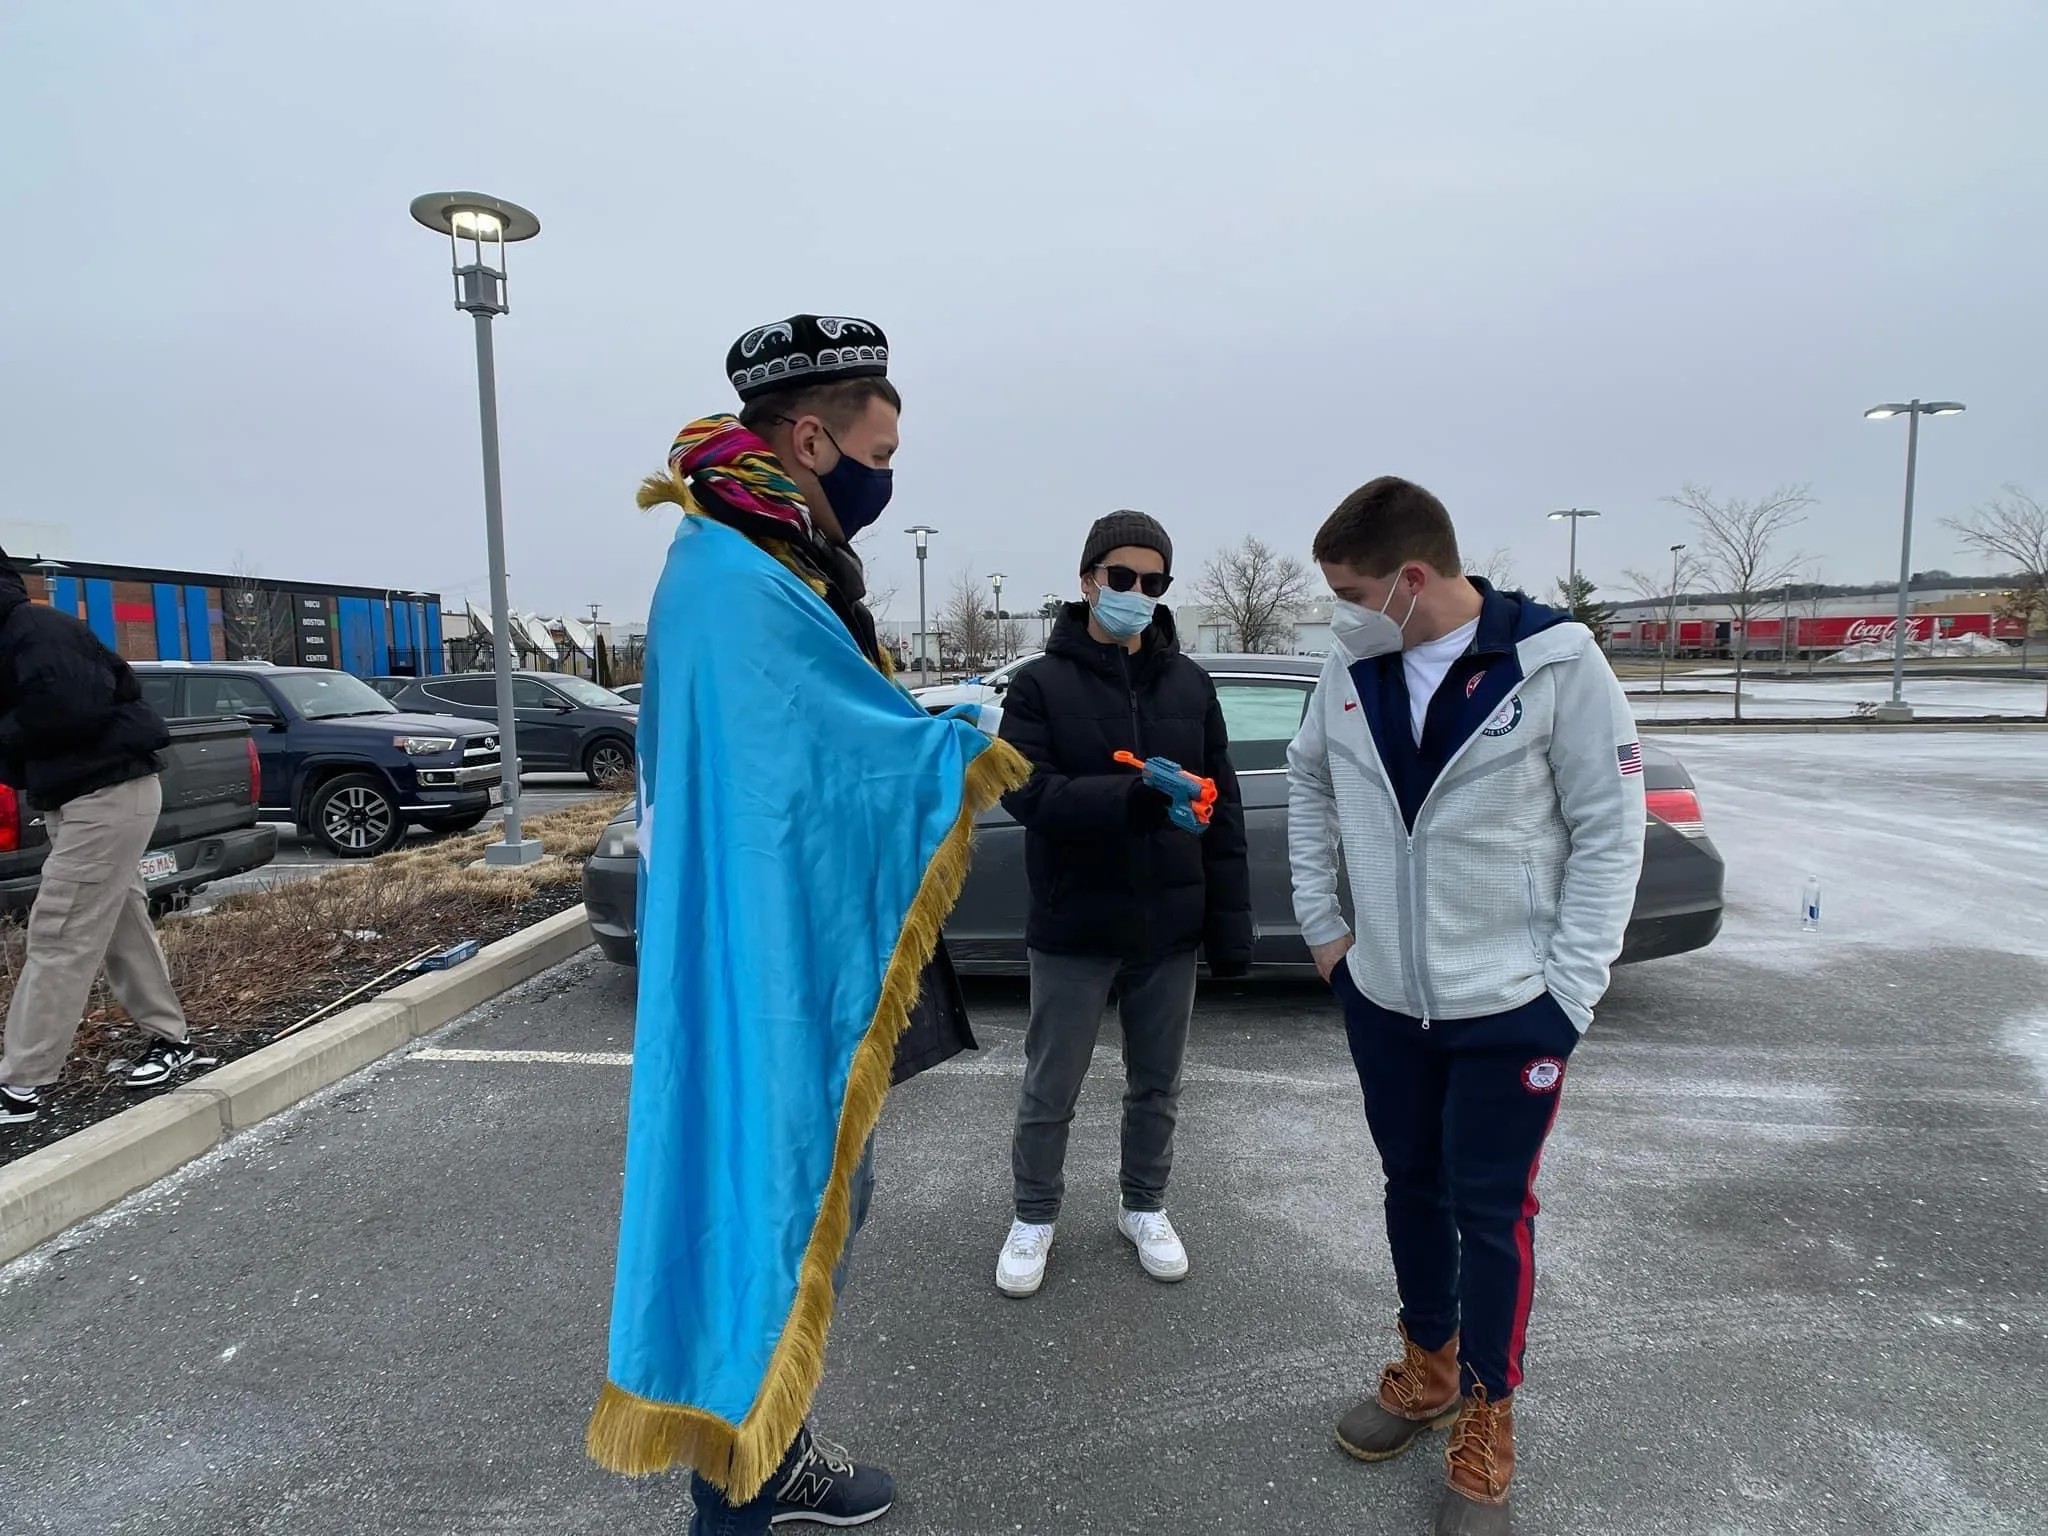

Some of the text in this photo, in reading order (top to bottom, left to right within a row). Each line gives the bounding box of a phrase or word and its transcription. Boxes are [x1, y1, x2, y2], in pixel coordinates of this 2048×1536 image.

[302, 618, 326, 626] BOSTON
[305, 654, 328, 662] CENTER
[787, 1471, 834, 1508] N
